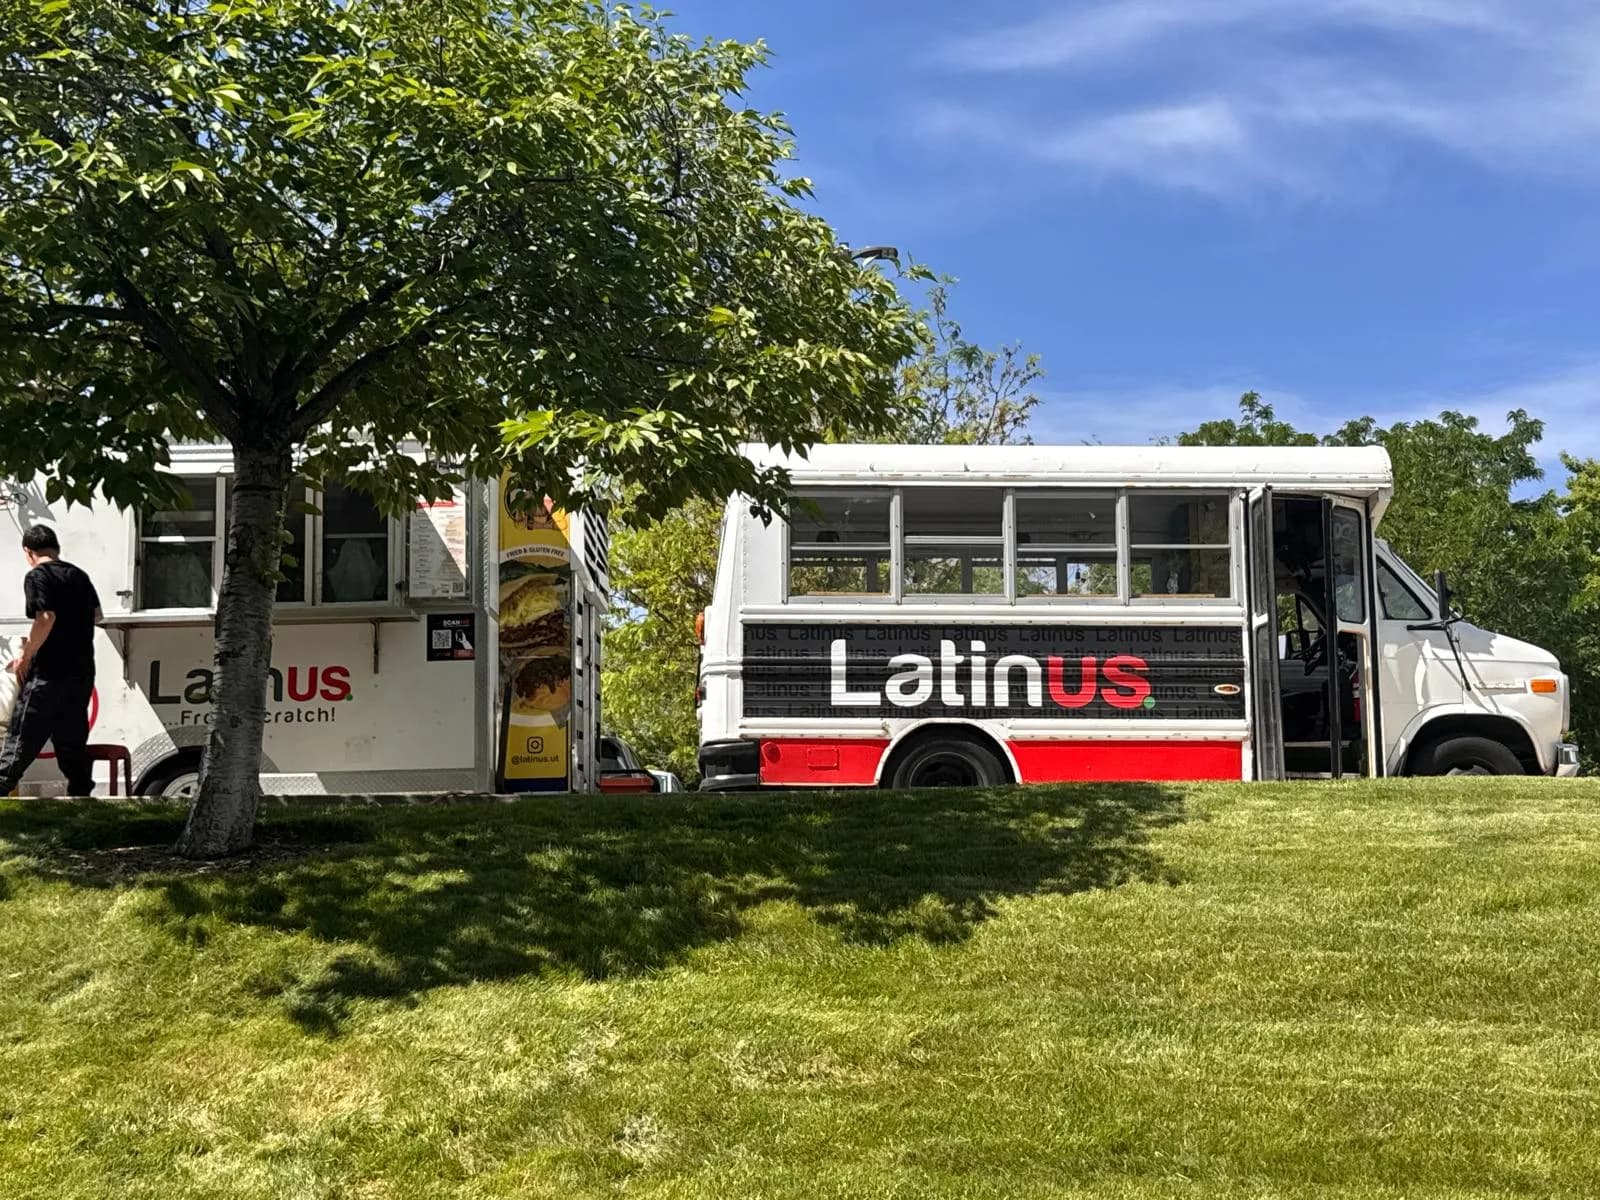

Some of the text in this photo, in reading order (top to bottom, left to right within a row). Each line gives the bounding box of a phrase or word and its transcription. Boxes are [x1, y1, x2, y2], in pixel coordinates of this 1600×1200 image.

[529, 546, 551, 554] GLUTEN
[263, 706, 336, 724] cratch!
[511, 754, 560, 766] @latinus.ut
